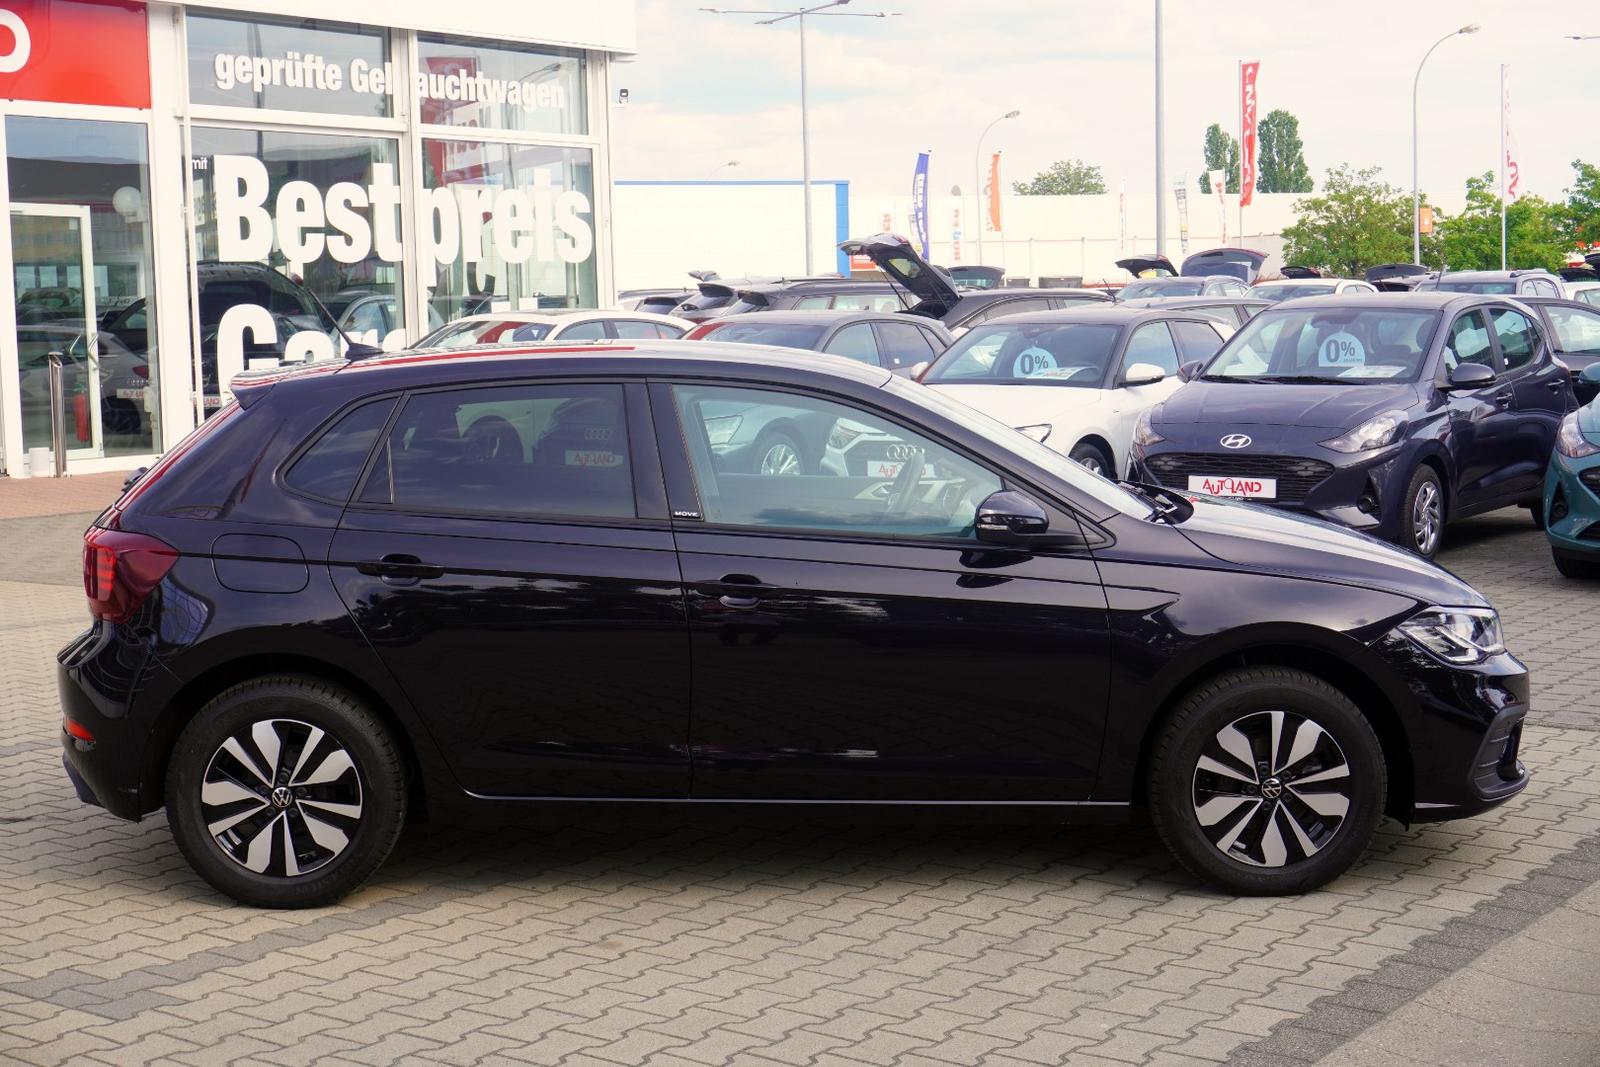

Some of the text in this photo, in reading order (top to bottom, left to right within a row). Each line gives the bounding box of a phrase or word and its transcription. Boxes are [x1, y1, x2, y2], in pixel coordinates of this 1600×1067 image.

[215, 51, 565, 112] geprüfte Geauchtwagen
[1326, 339, 1356, 363] 0%
[1021, 354, 1049, 375] 0%
[1203, 478, 1262, 496] AUTOLAND
